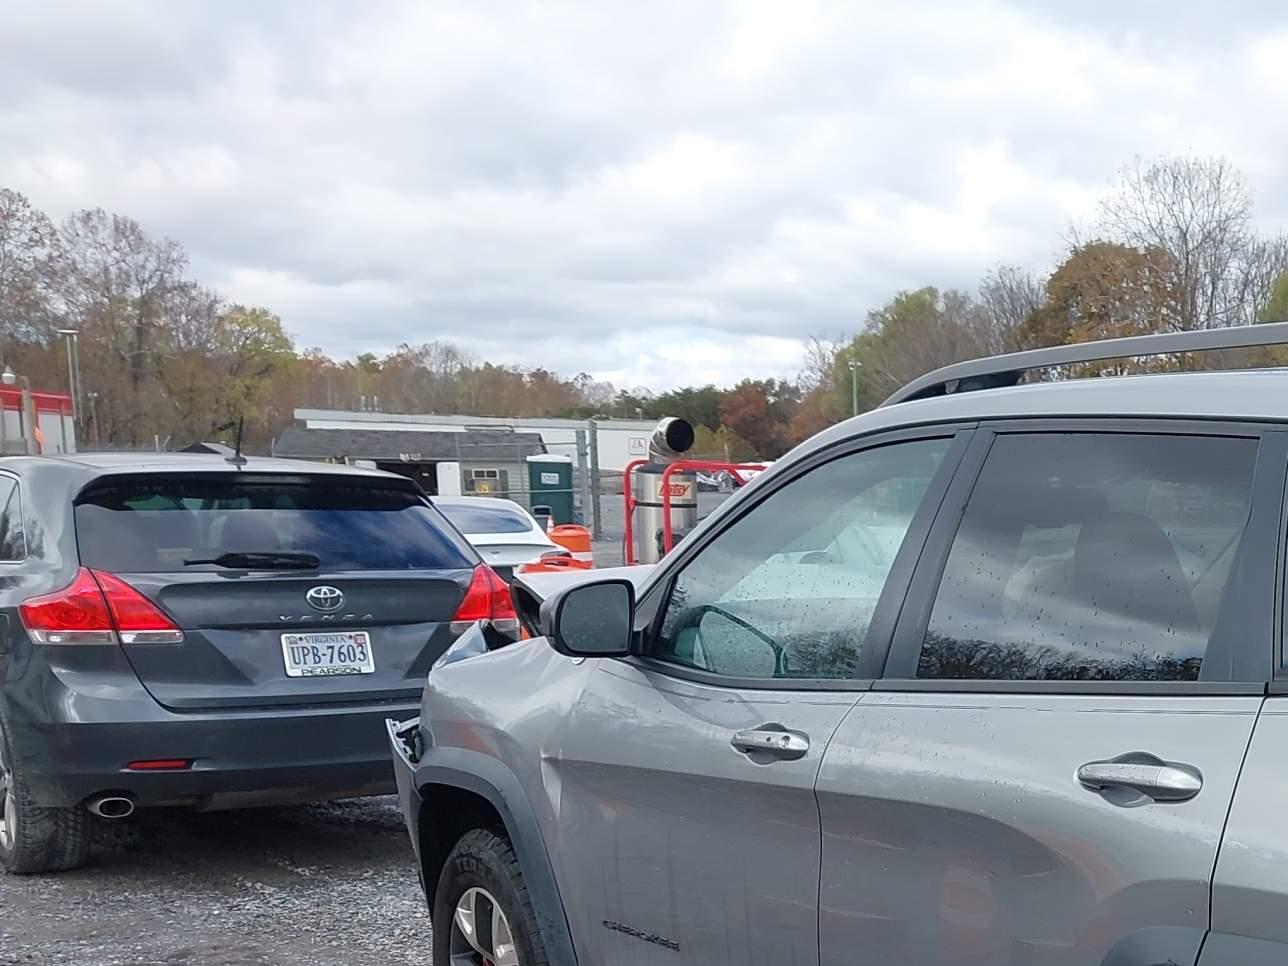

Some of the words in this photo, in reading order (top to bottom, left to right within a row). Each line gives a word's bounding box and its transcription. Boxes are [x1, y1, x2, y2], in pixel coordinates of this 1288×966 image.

[304, 636, 346, 644] VIRGINIA
[290, 644, 366, 665] UPB-7603
[301, 666, 361, 676] PEARSON
